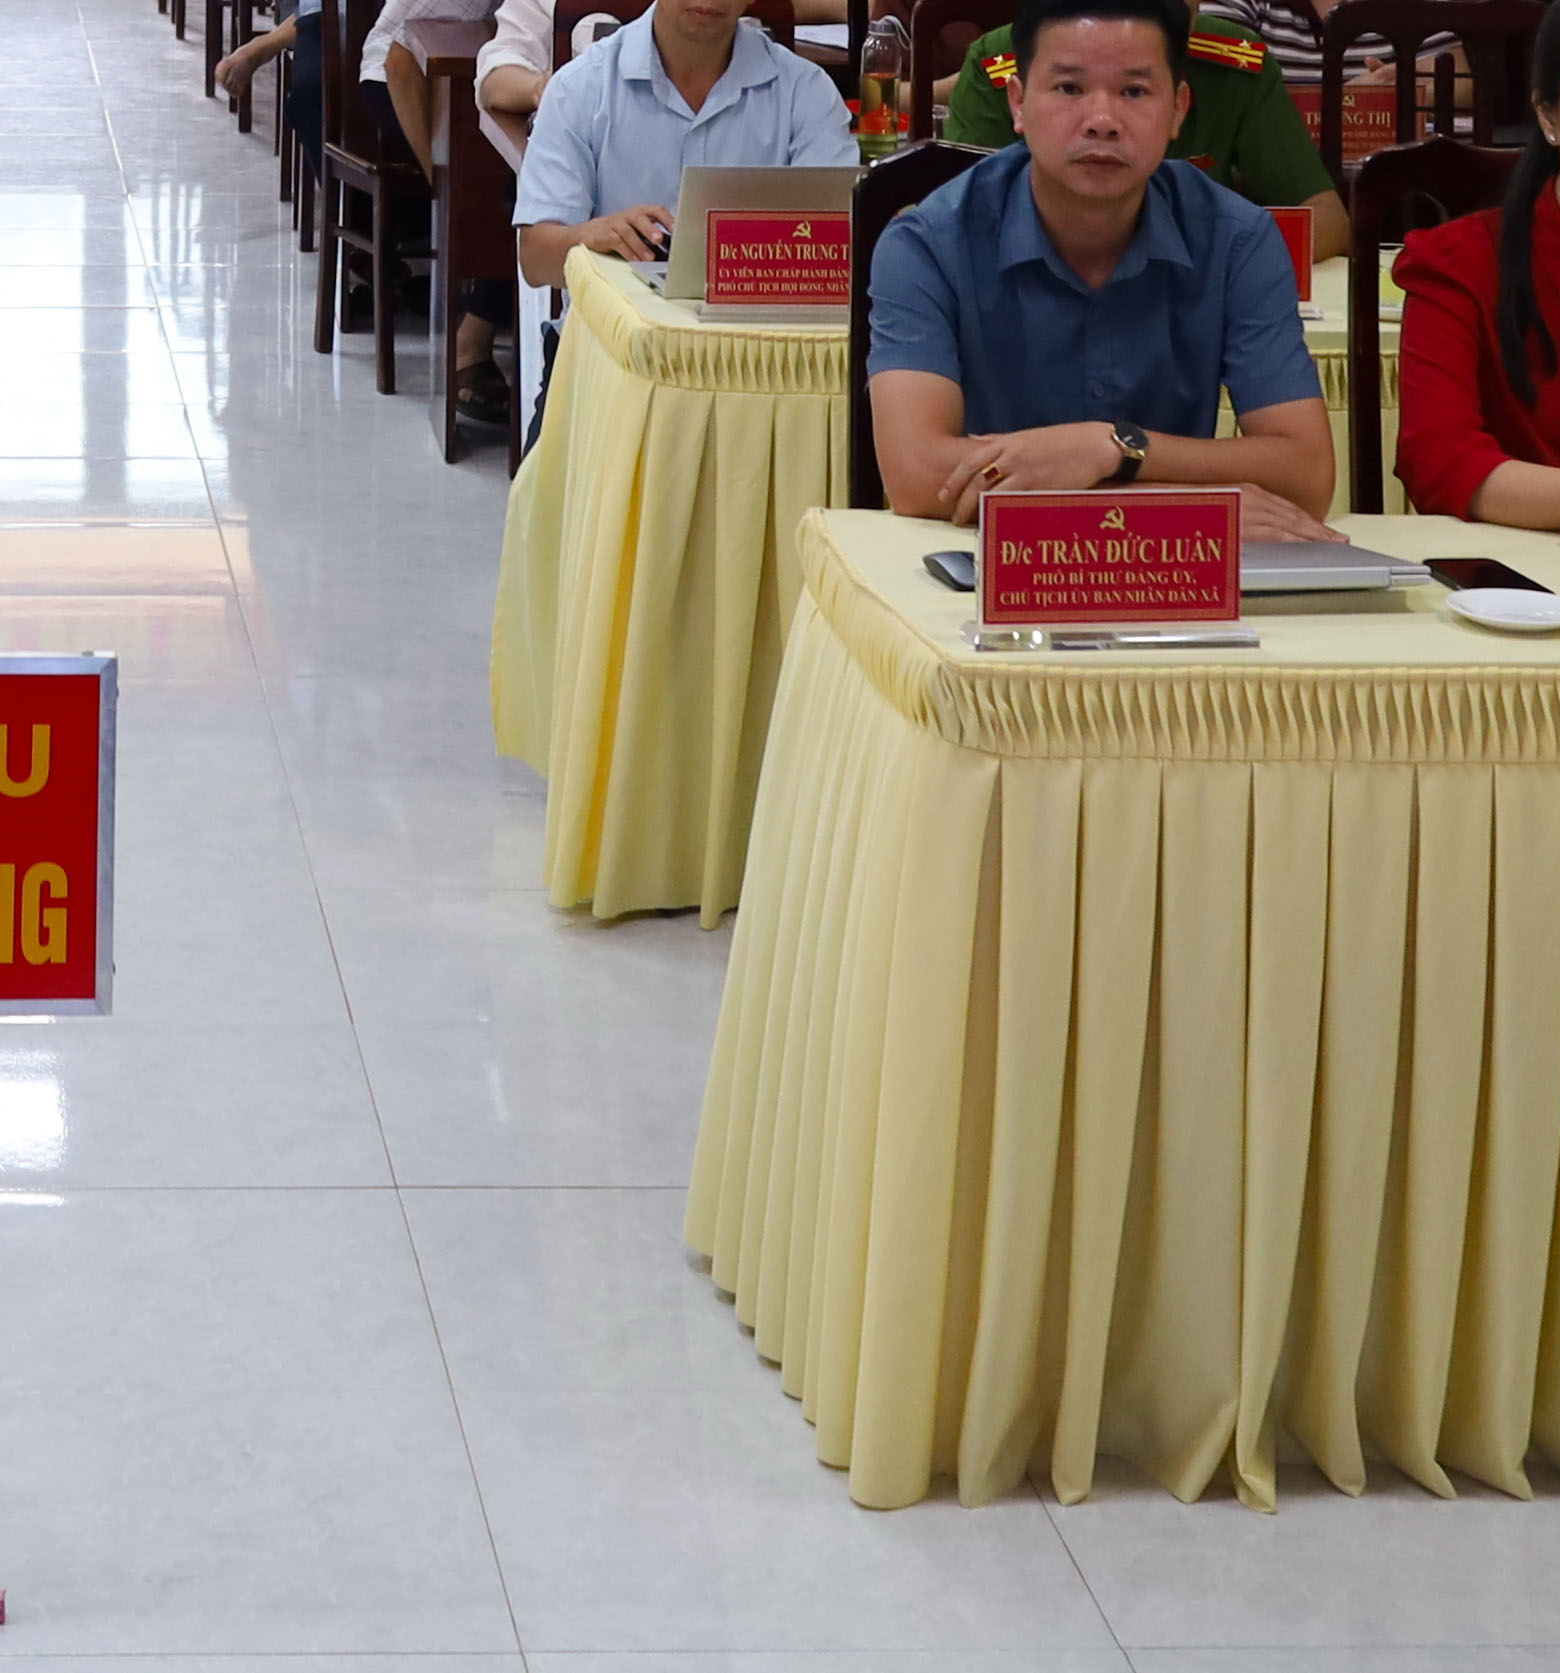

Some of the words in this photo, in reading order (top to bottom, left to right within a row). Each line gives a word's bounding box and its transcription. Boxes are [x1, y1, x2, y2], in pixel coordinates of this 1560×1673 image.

[1305, 112, 1363, 125] TRNG
[741, 239, 792, 260] NGUYỄN
[794, 244, 838, 260] TRUNG
[829, 267, 849, 278] ĐẢN
[1000, 540, 1033, 565] Đ/c
[1105, 531, 1155, 564] ĐỨC
[1160, 530, 1222, 563] LUÂN
[1033, 569, 1065, 585] PHÓ
[1069, 568, 1084, 585] BÍ
[1088, 570, 1123, 585] THƯ
[1125, 568, 1169, 585] ĐẢNG
